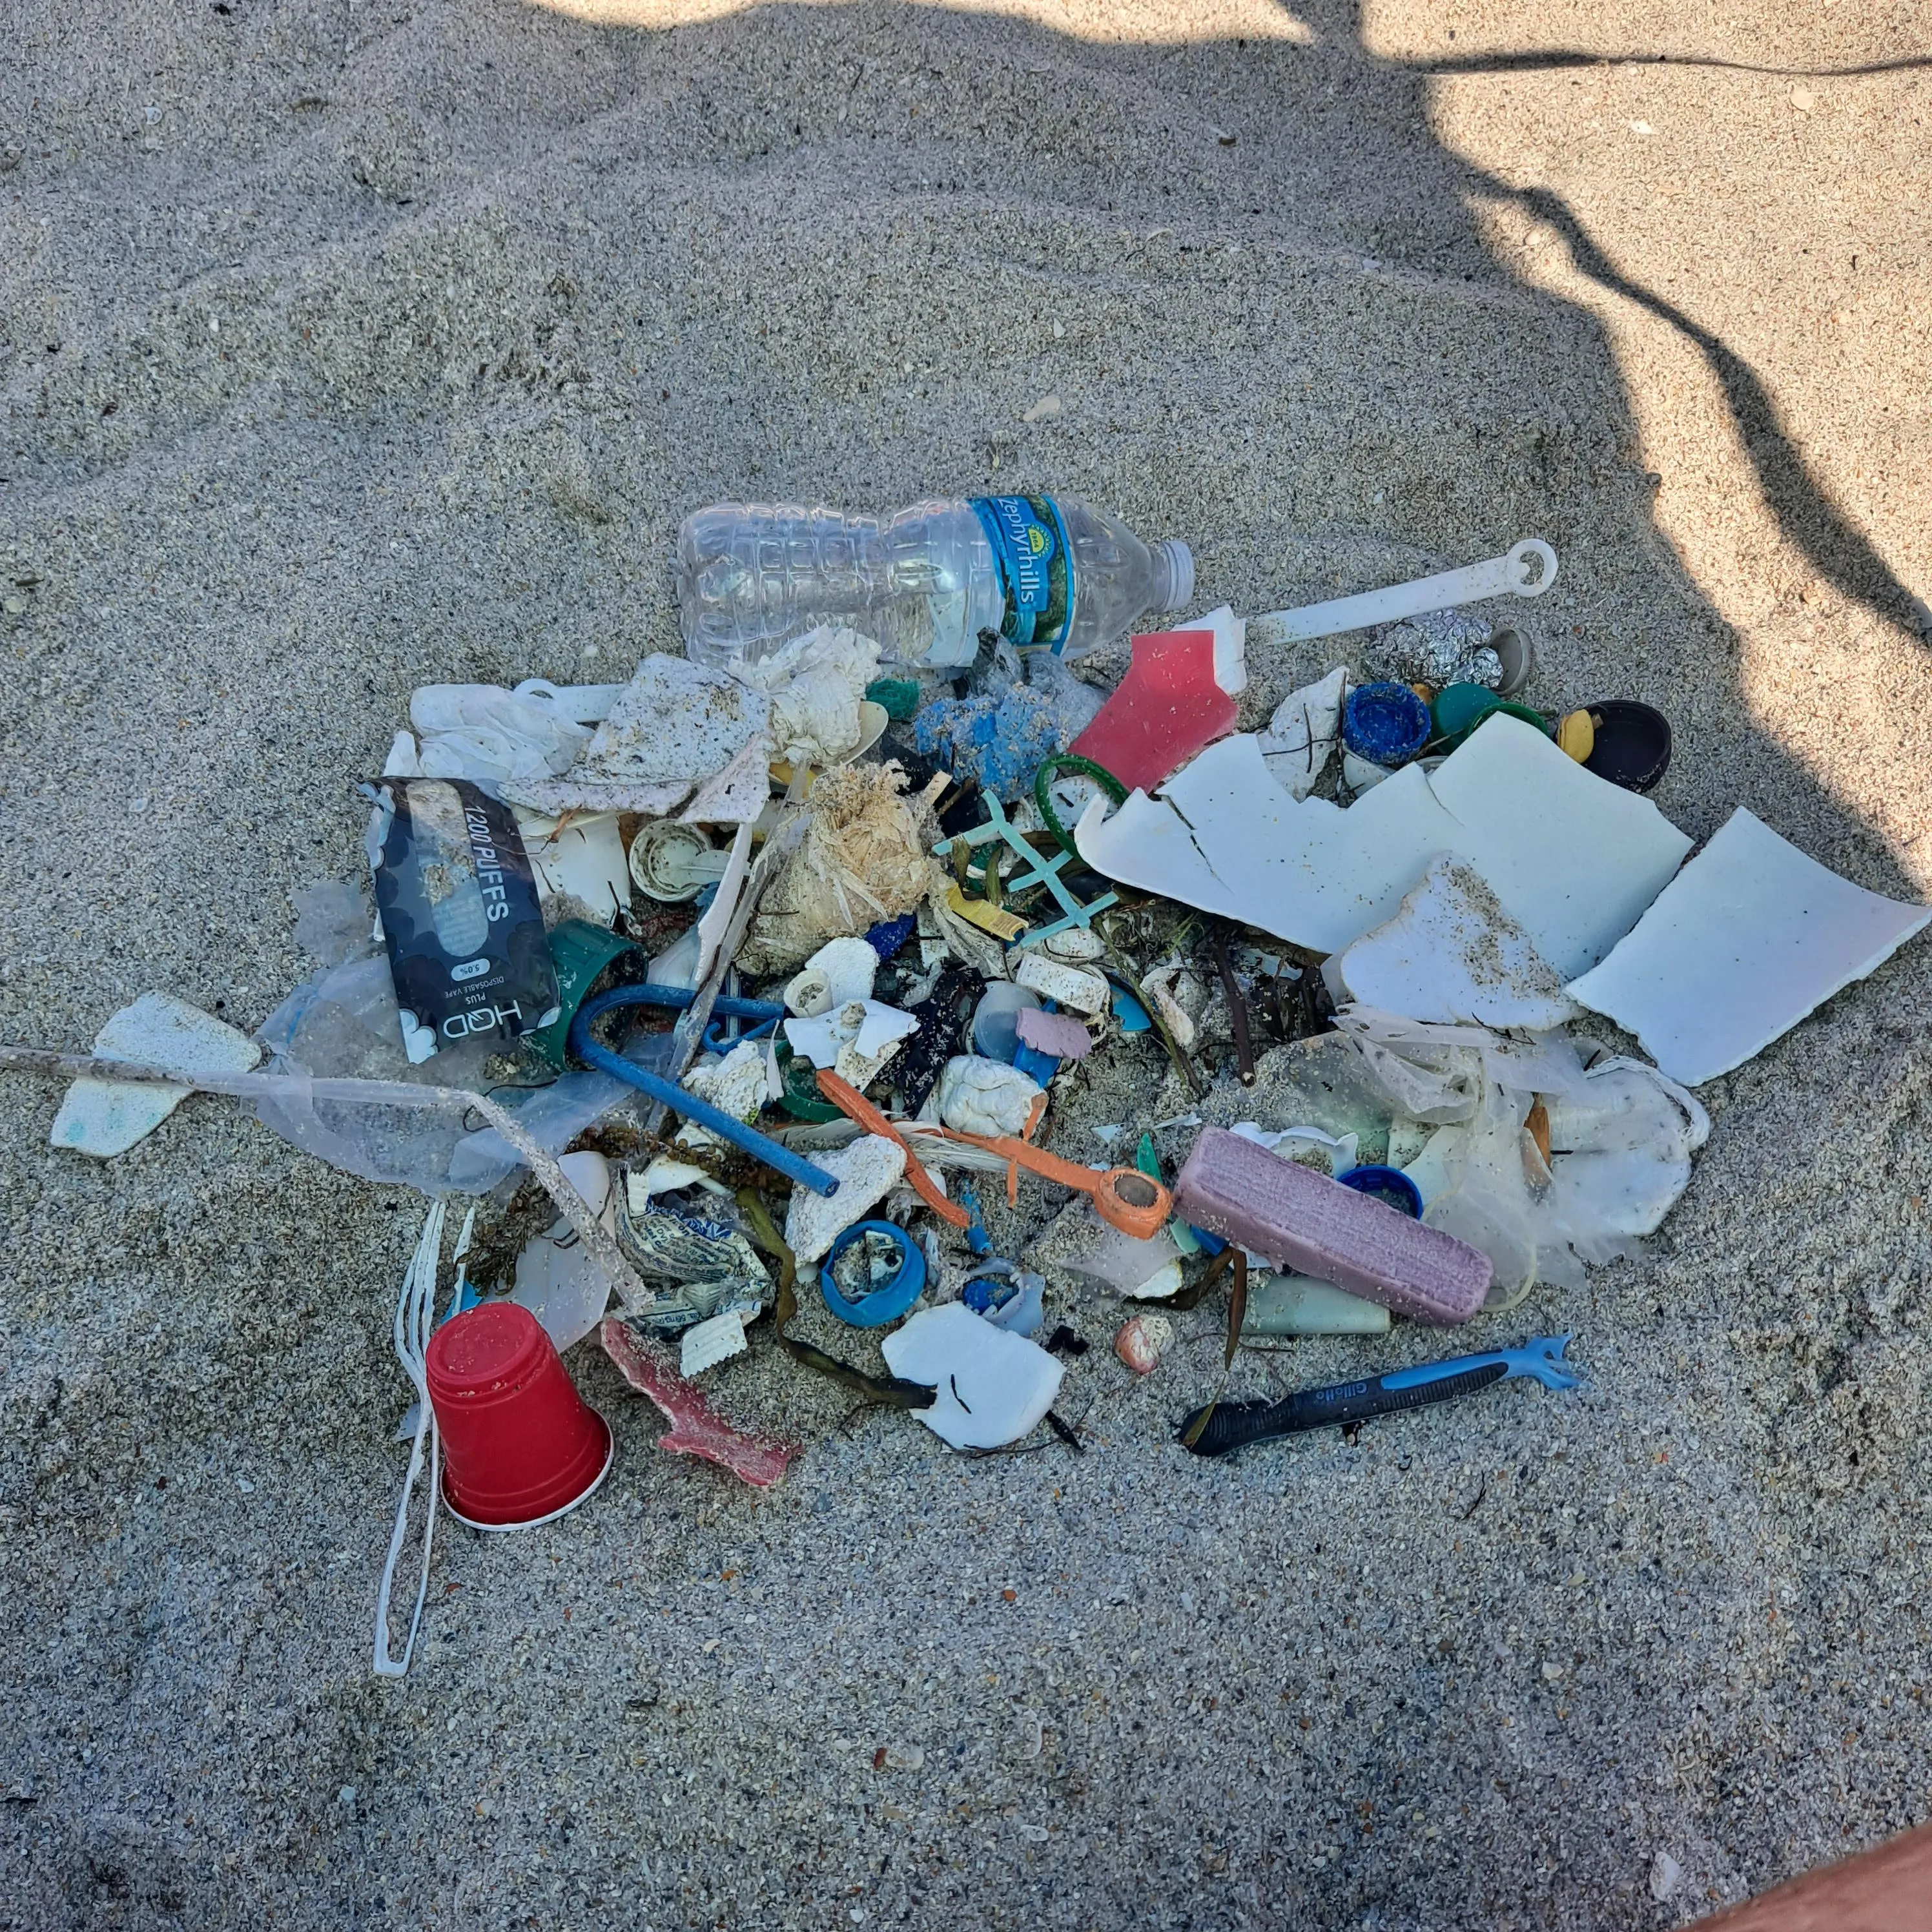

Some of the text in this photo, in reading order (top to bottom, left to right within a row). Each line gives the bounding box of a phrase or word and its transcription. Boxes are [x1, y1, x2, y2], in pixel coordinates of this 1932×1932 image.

[997, 498, 1040, 604] Zephyrhills
[464, 805, 509, 922] 1200 PUFFS
[459, 964, 480, 976] 5.0%
[444, 976, 504, 999] DISPOSABLE VAPE
[465, 992, 486, 1005] PLUS
[443, 1000, 522, 1038] HQD
[1315, 1382, 1368, 1401] Gillette
